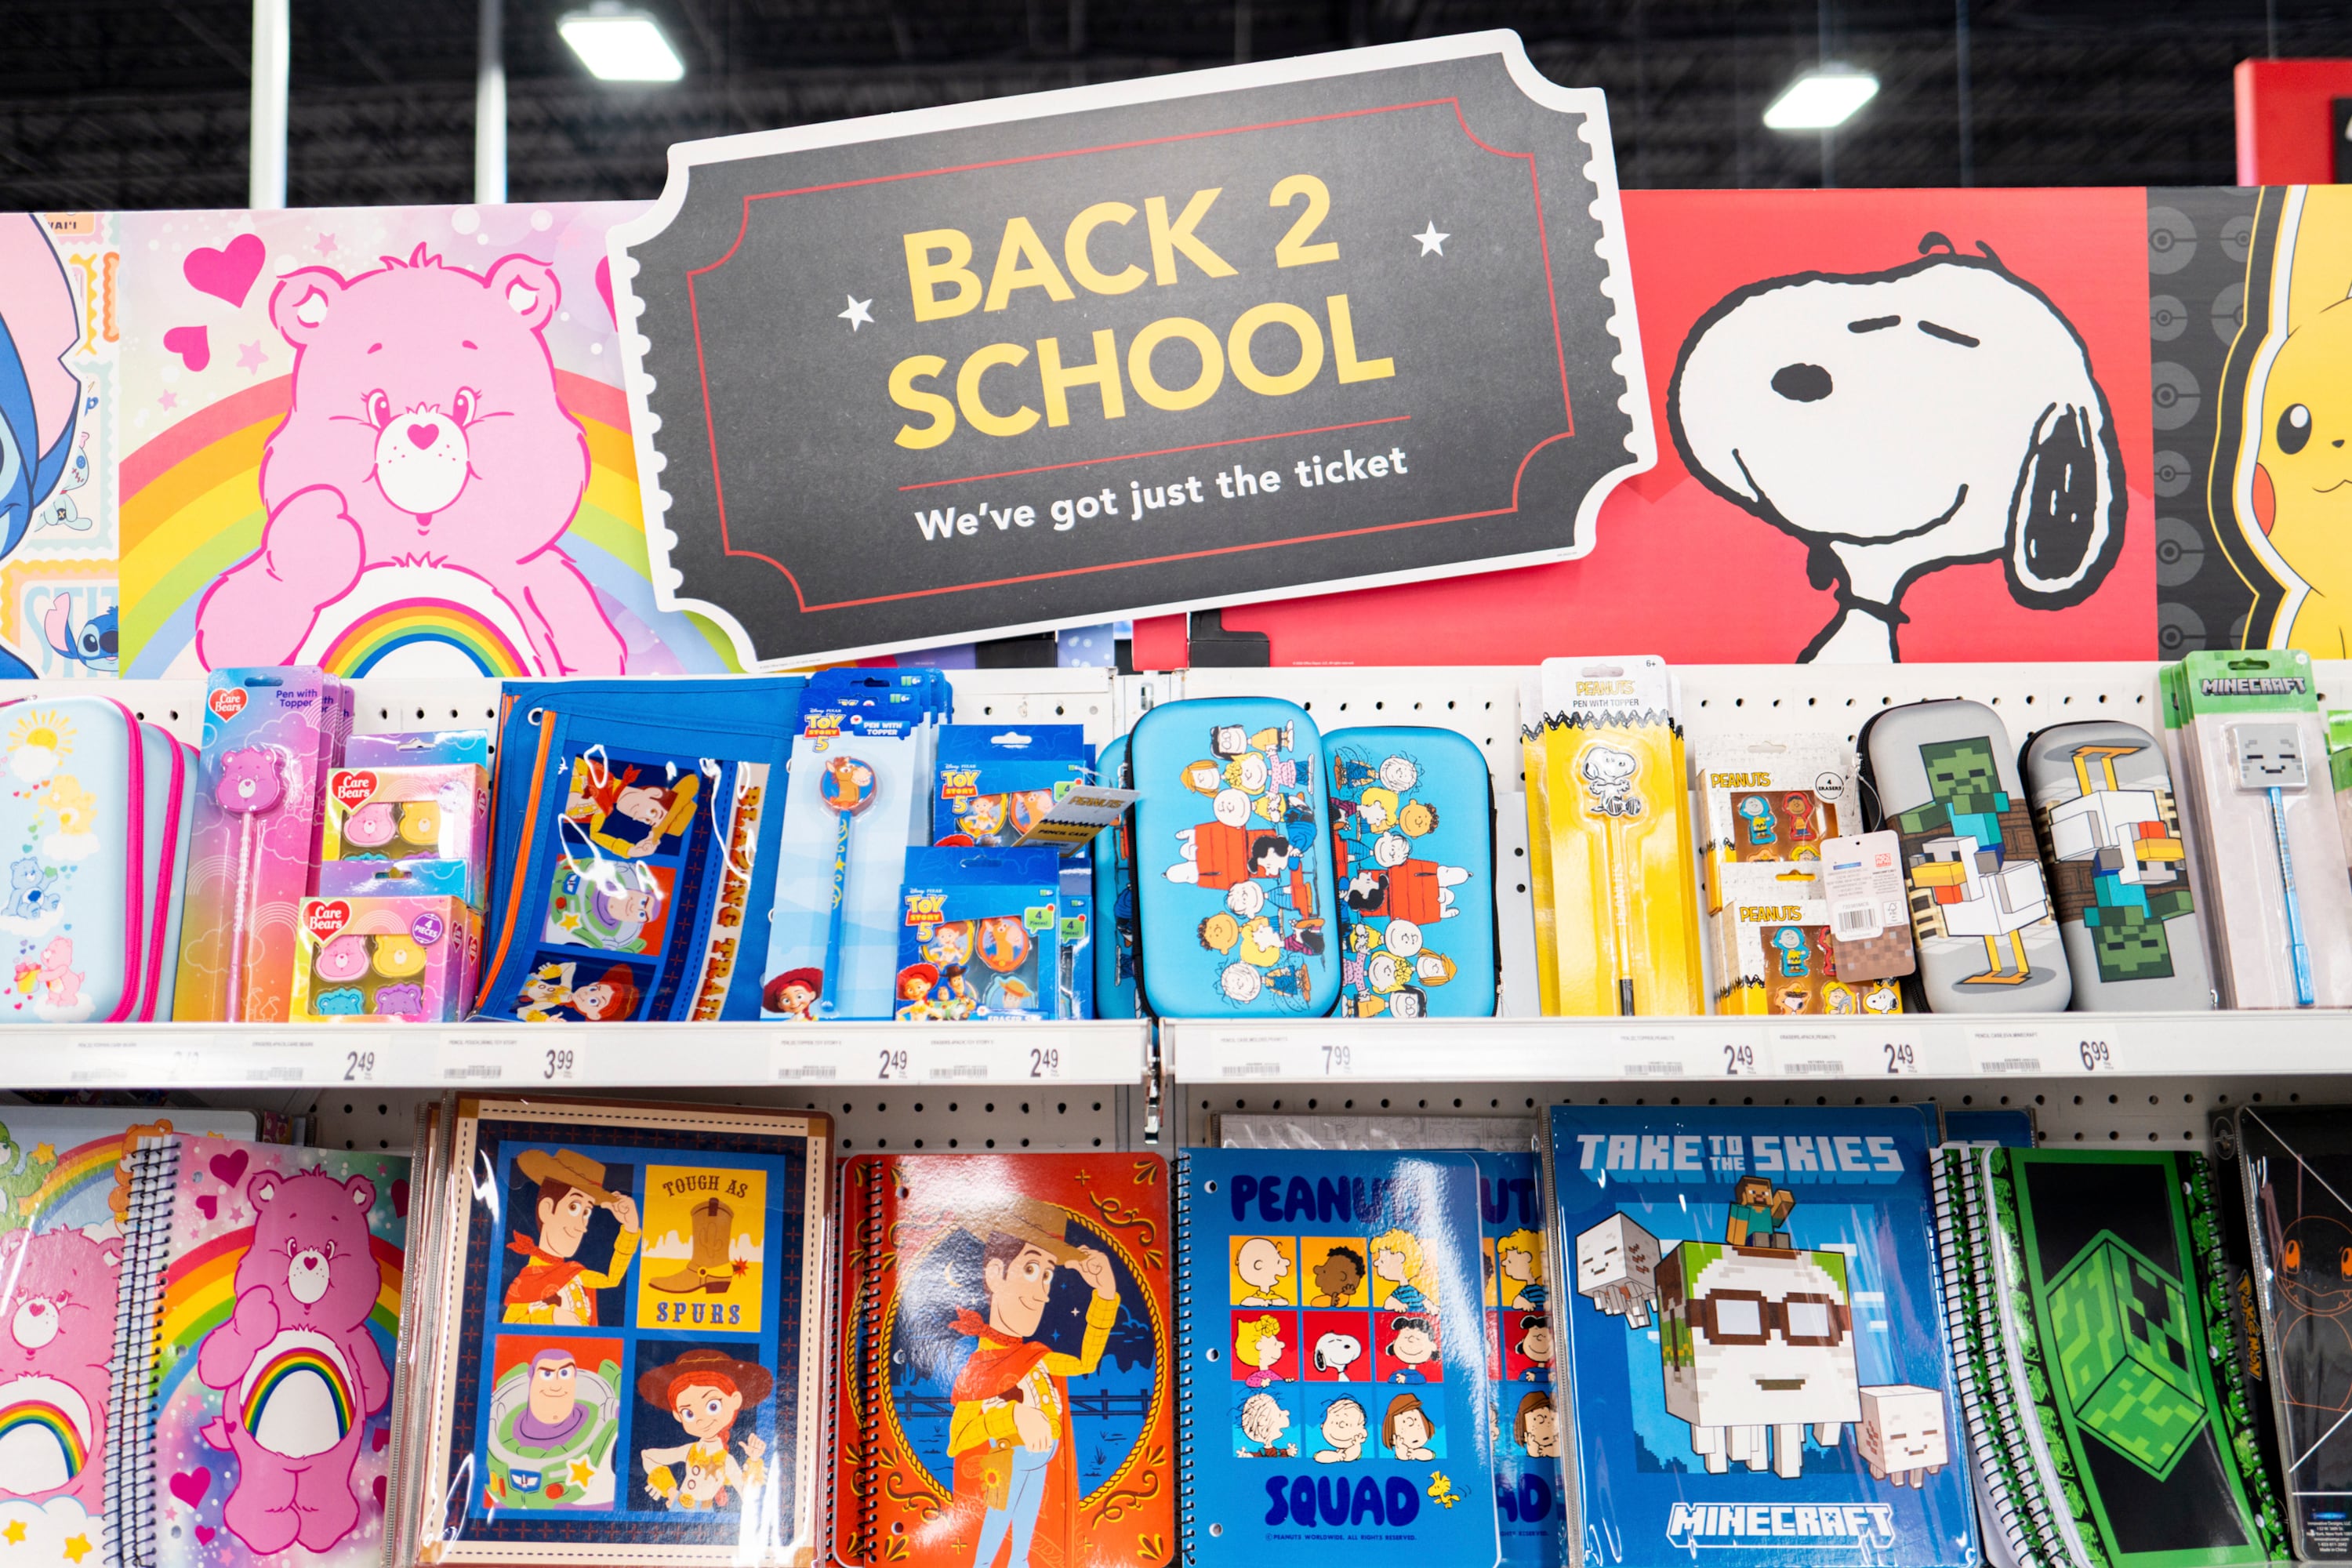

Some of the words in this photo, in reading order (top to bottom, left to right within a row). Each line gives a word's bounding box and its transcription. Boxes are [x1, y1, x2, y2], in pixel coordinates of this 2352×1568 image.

[903, 187, 1239, 322] BACK
[1269, 174, 1340, 267] 2
[888, 294, 1396, 449] SCHOOL
[915, 502, 1036, 540] We've
[1051, 488, 1119, 532] got
[1131, 475, 1204, 520] just
[1215, 465, 1282, 499] the
[1294, 447, 1408, 488] ticket
[296, 689, 318, 698] with
[1576, 681, 1635, 695] PEANUTS
[2201, 677, 2307, 696] MINECRAFT
[215, 701, 241, 712] Bears
[220, 693, 241, 704] Care
[280, 699, 312, 709] Topper
[806, 714, 845, 729] TOY
[814, 736, 829, 751] 5
[343, 775, 369, 787] Care
[942, 771, 979, 786] TOY
[1710, 772, 1771, 788] PEANUTS
[337, 786, 371, 799] Bears
[953, 796, 968, 813] 5
[1068, 796, 1125, 808] PEANUTS
[717, 785, 761, 927] BLAZING
[906, 895, 946, 913] TOY
[314, 906, 342, 919] Care
[1740, 906, 1802, 923] PEANUTS
[309, 916, 343, 930] Bears
[414, 924, 438, 938] PIECES
[424, 920, 433, 928] 4
[918, 921, 932, 941] 5
[1067, 920, 1074, 929] 4
[1577, 1134, 1703, 1172] TAKE
[1708, 1135, 1744, 1156] TO
[1751, 1135, 1904, 1173] SKIES
[1709, 1156, 1745, 1172] THE
[662, 1175, 720, 1198] TOUGH
[725, 1179, 748, 1198] AS
[1231, 1174, 1427, 1224] PEANUT
[656, 1301, 741, 1325] SPURS
[1265, 1475, 1420, 1529] SQUAD
[1668, 1503, 1893, 1544] MINECRAFT
